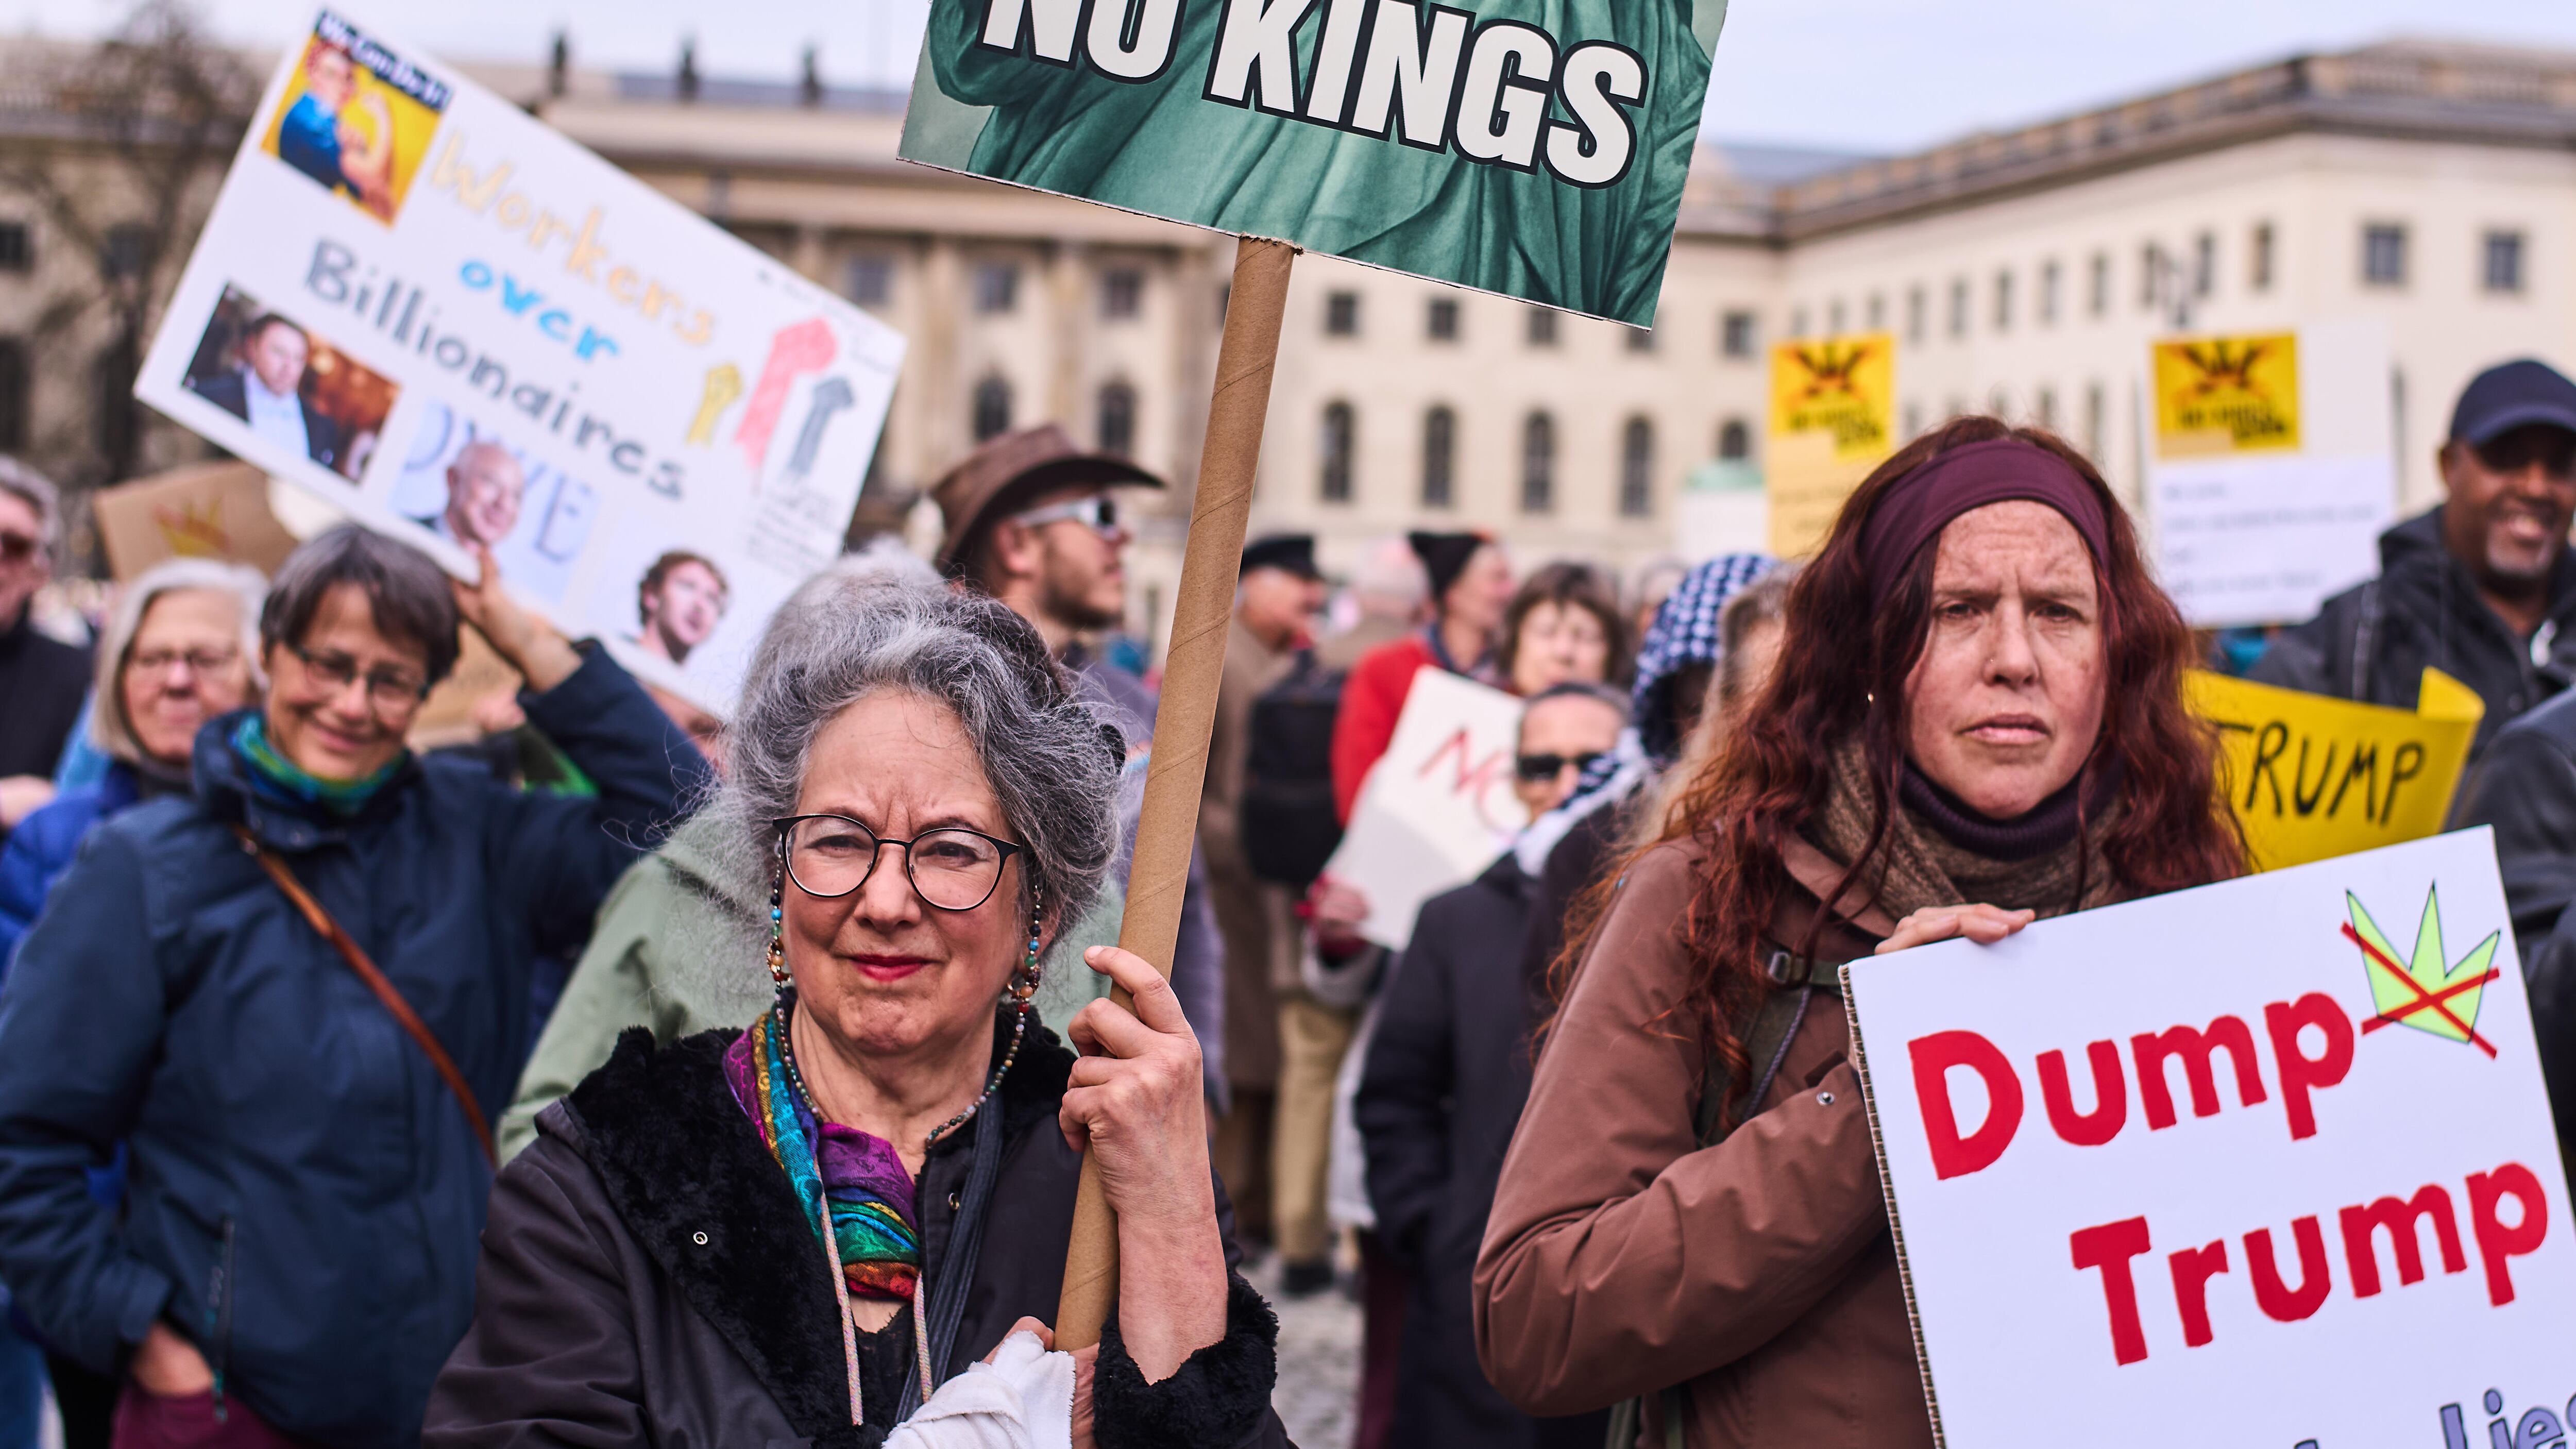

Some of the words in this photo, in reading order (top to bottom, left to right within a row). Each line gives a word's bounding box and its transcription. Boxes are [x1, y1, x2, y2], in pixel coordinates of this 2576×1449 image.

[1202, 0, 1649, 189] KINGS
[431, 130, 717, 346] Workers
[459, 259, 620, 363] over
[305, 238, 686, 502] Billionaires
[1908, 993, 2354, 1180] Dump
[2071, 1164, 2548, 1366] Trump
[2439, 1388, 2576, 1449] ie
